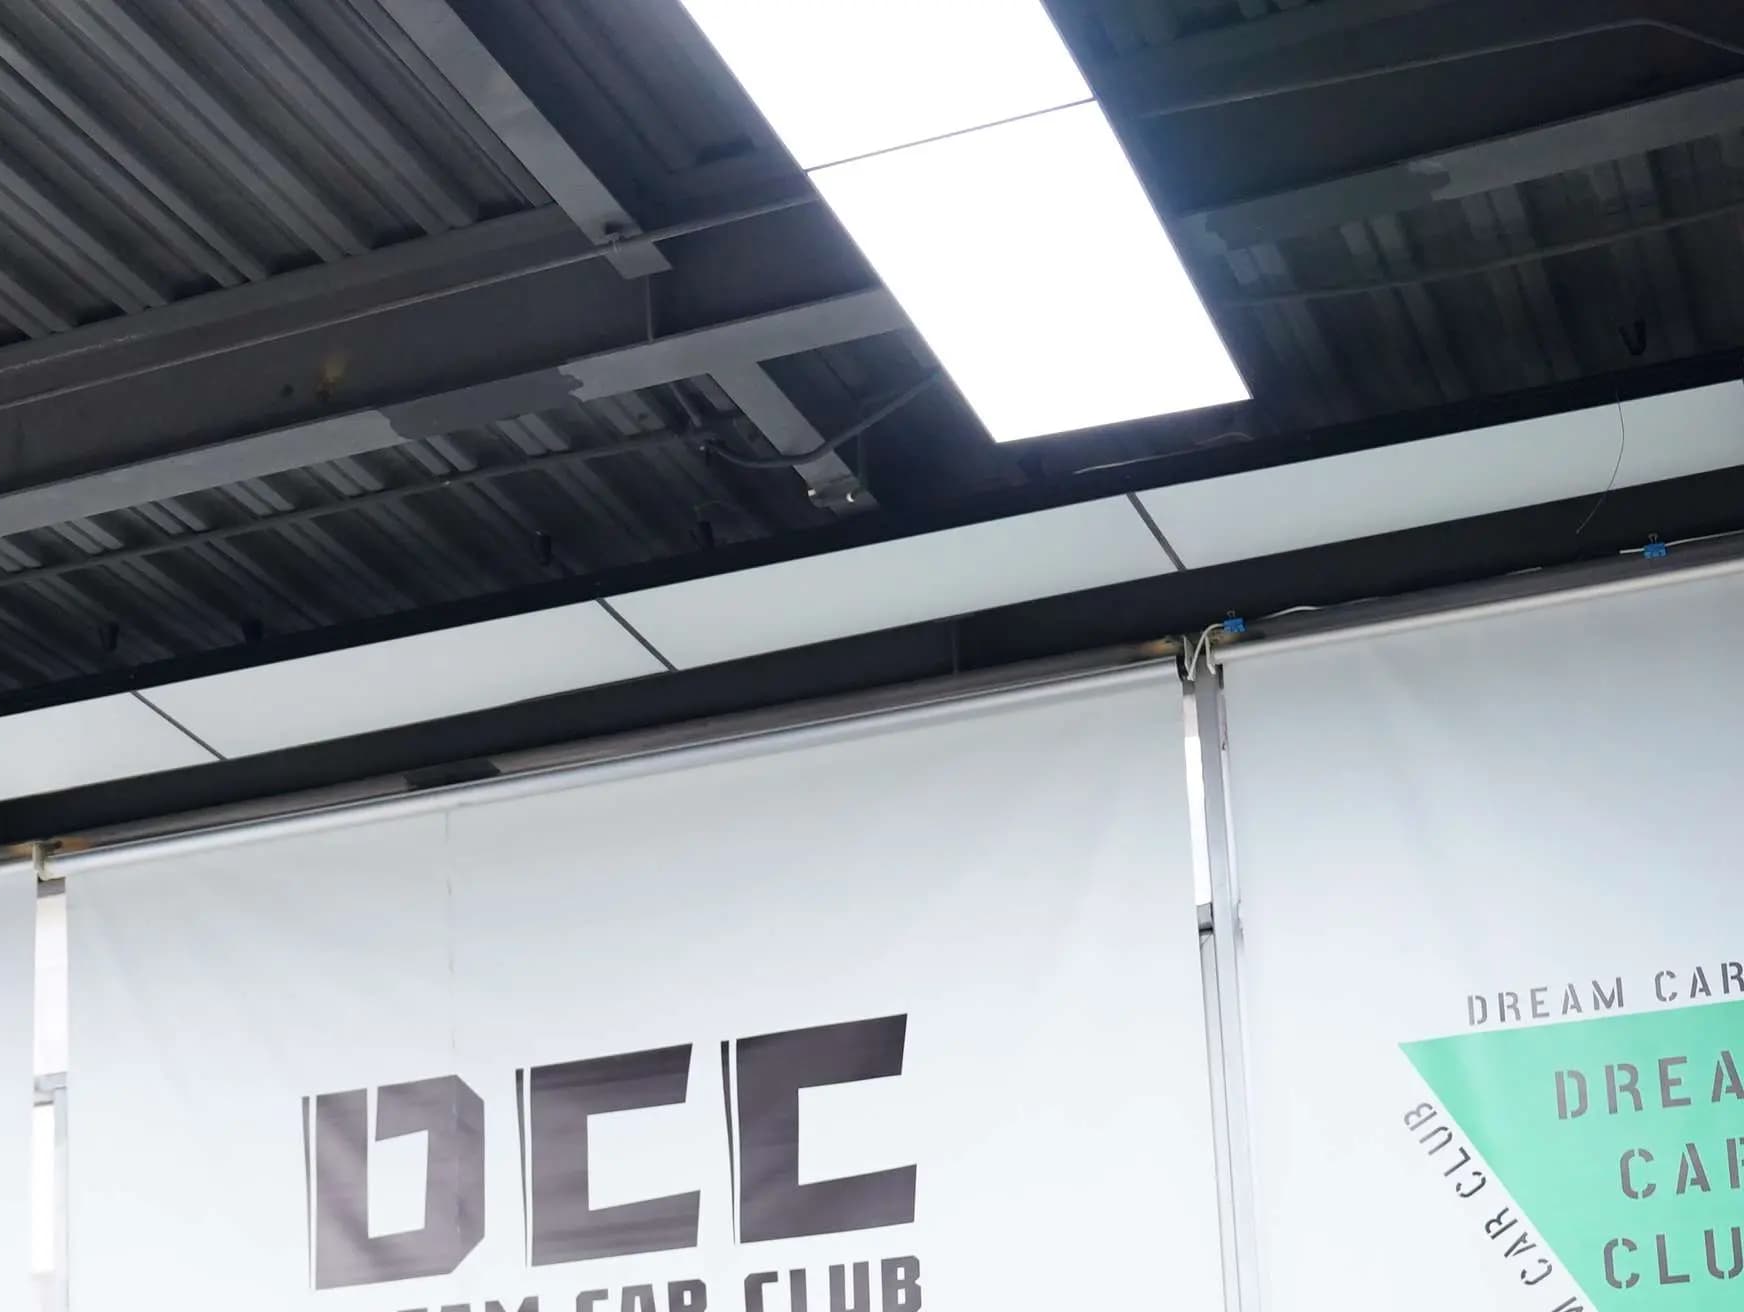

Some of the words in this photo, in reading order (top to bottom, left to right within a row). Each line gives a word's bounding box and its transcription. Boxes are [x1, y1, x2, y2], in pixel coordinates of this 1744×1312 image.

[1467, 977, 1625, 1027] DREAM
[1653, 961, 1744, 1003] CAR
[1554, 1049, 1744, 1121] DREA
[301, 1012, 917, 1290] DCC
[1402, 1101, 1487, 1199] CLUB
[1484, 1206, 1553, 1286] CAR
[1603, 1226, 1744, 1290] CLU
